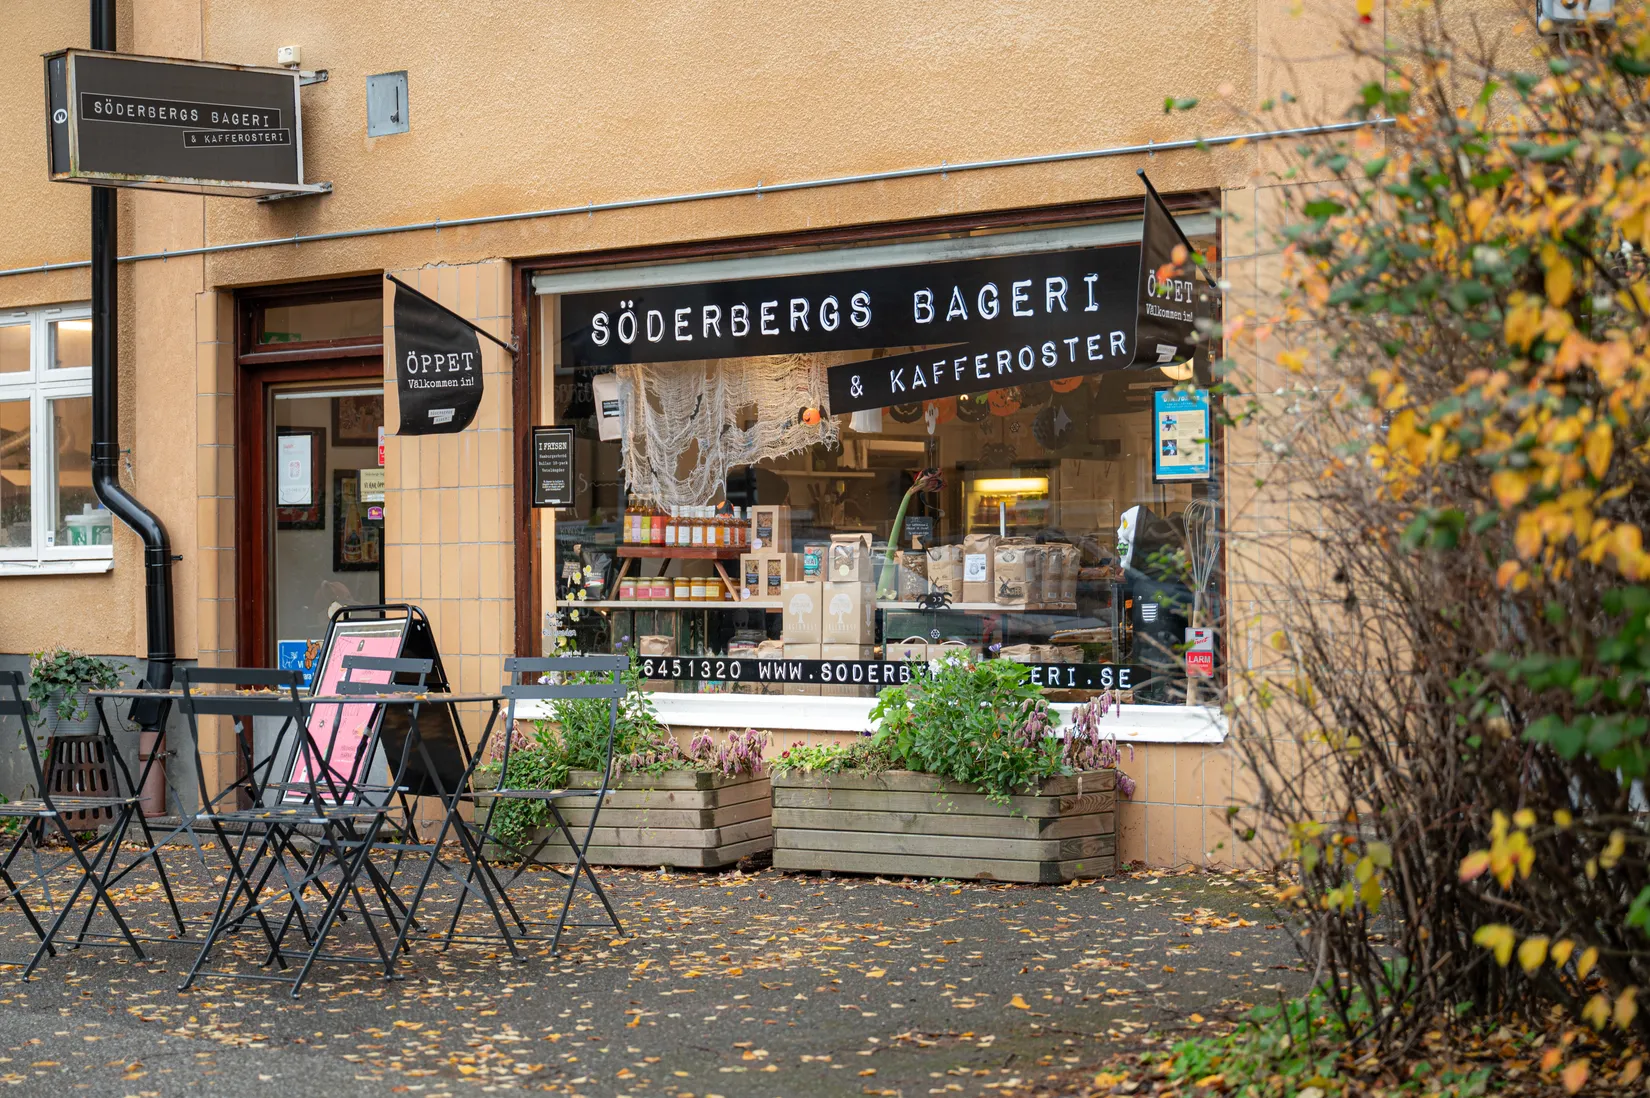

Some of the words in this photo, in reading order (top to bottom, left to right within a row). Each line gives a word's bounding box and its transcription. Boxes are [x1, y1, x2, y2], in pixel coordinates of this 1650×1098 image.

[94, 99, 198, 121] SÖDERBERGS
[211, 112, 269, 127] BAGERI
[191, 135, 197, 143] &
[204, 132, 283, 143] KAFFEROSTERI
[591, 290, 872, 347] SÖDERBERGS
[913, 273, 1099, 324] BAGERI
[1146, 303, 1182, 321] Välkommen
[1183, 311, 1193, 322] in!
[406, 350, 474, 374] ÖPPET
[850, 375, 863, 398] &
[890, 330, 1127, 393] KAFFEROSTER
[408, 378, 459, 389] Välkommen
[460, 376, 474, 387] in!
[539, 442, 543, 451] I
[544, 442, 567, 450] FRYSEN
[644, 659, 741, 679] 6451320
